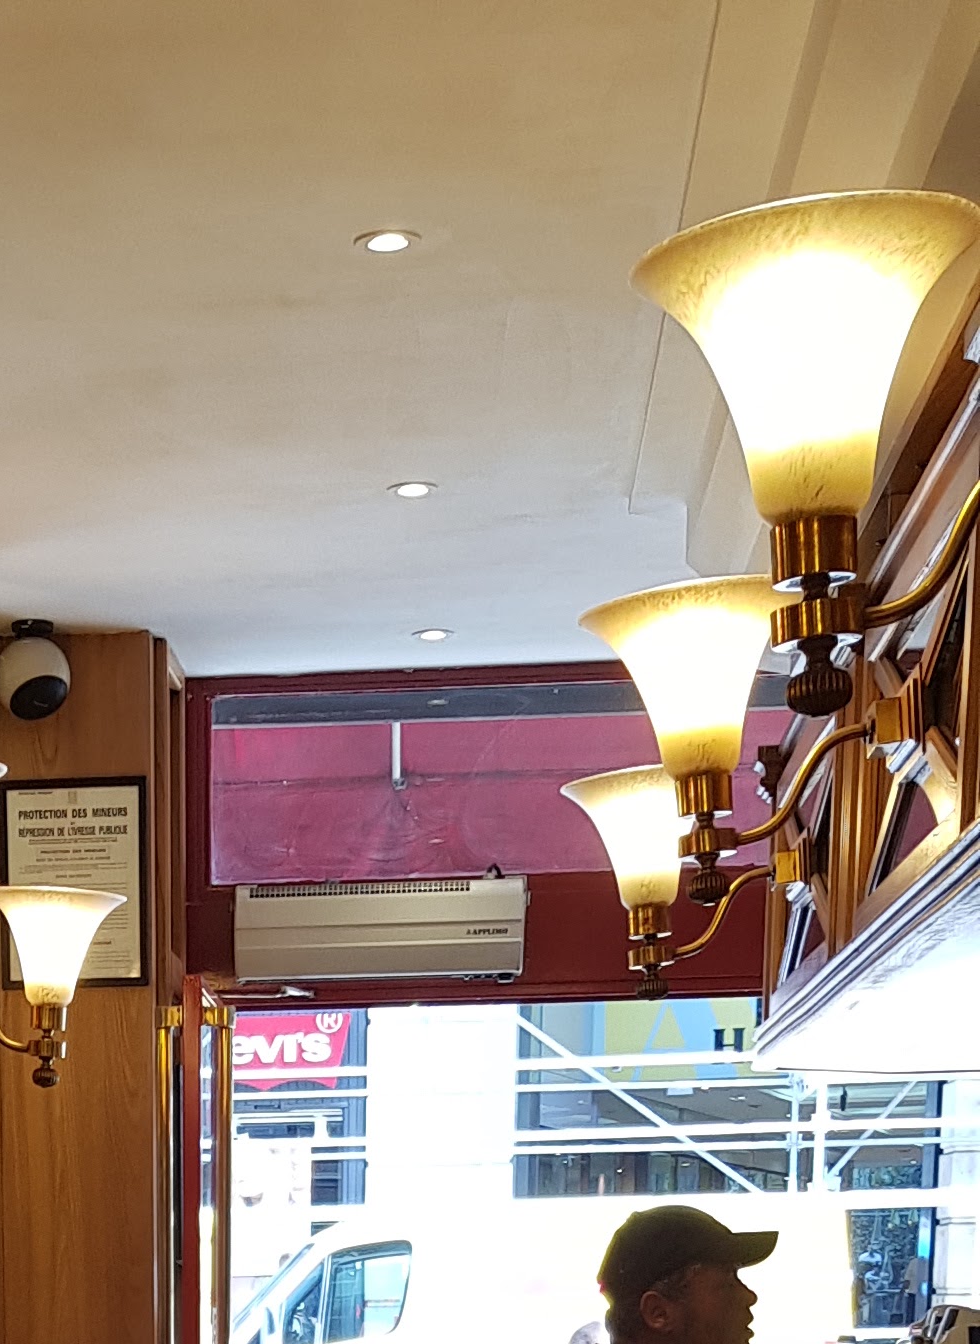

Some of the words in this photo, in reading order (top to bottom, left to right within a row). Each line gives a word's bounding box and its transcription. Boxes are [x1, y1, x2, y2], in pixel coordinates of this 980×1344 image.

[18, 809, 67, 820] PROTECTION
[72, 808, 87, 818] DES
[92, 807, 128, 817] MINEURS
[57, 826, 65, 836] DE
[99, 825, 128, 835] PUBLIQUE
[232, 1032, 332, 1065] evi's
